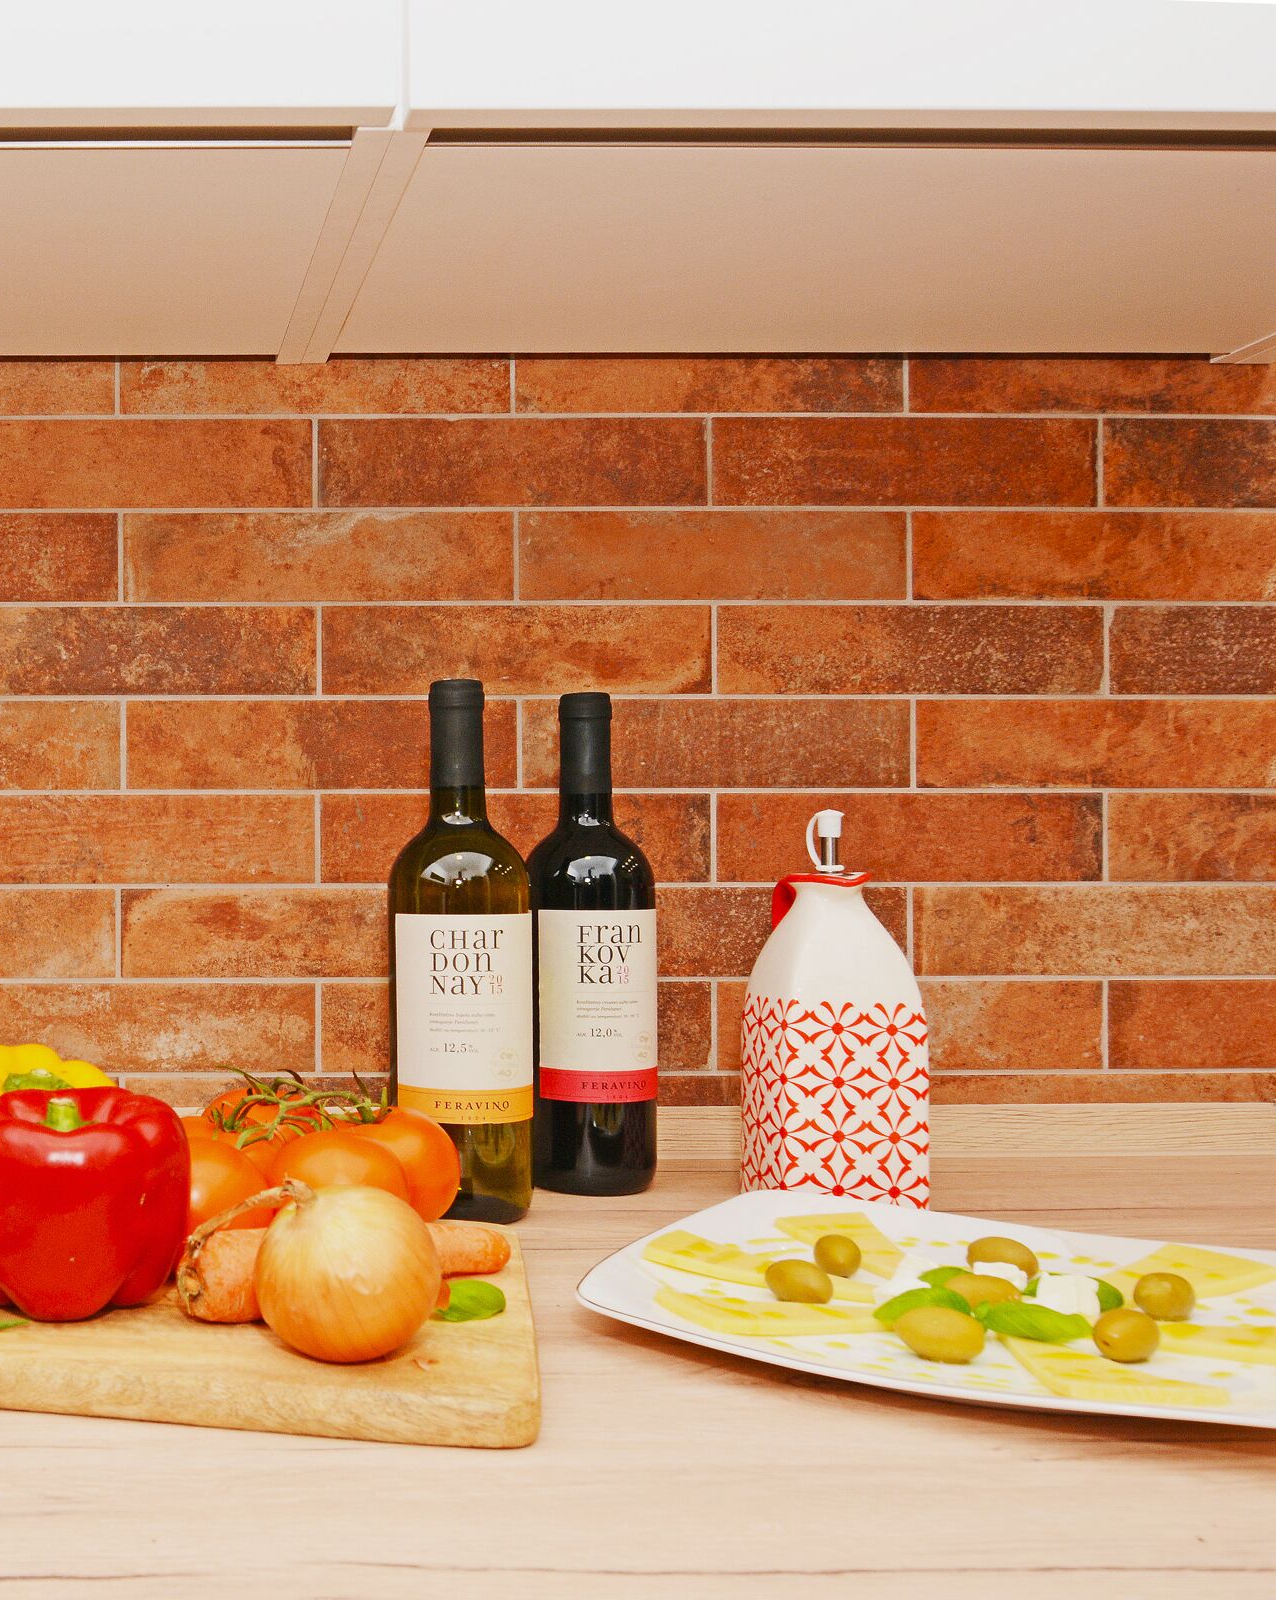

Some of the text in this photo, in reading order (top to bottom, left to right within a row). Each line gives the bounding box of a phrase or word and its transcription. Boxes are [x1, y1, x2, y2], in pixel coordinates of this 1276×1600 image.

[616, 965, 630, 975] 20
[488, 974, 503, 985] 20
[618, 975, 630, 985] 15
[490, 984, 503, 995] 15
[581, 1080, 647, 1091] FERAVINO
[435, 1100, 510, 1112] FERAVINO
